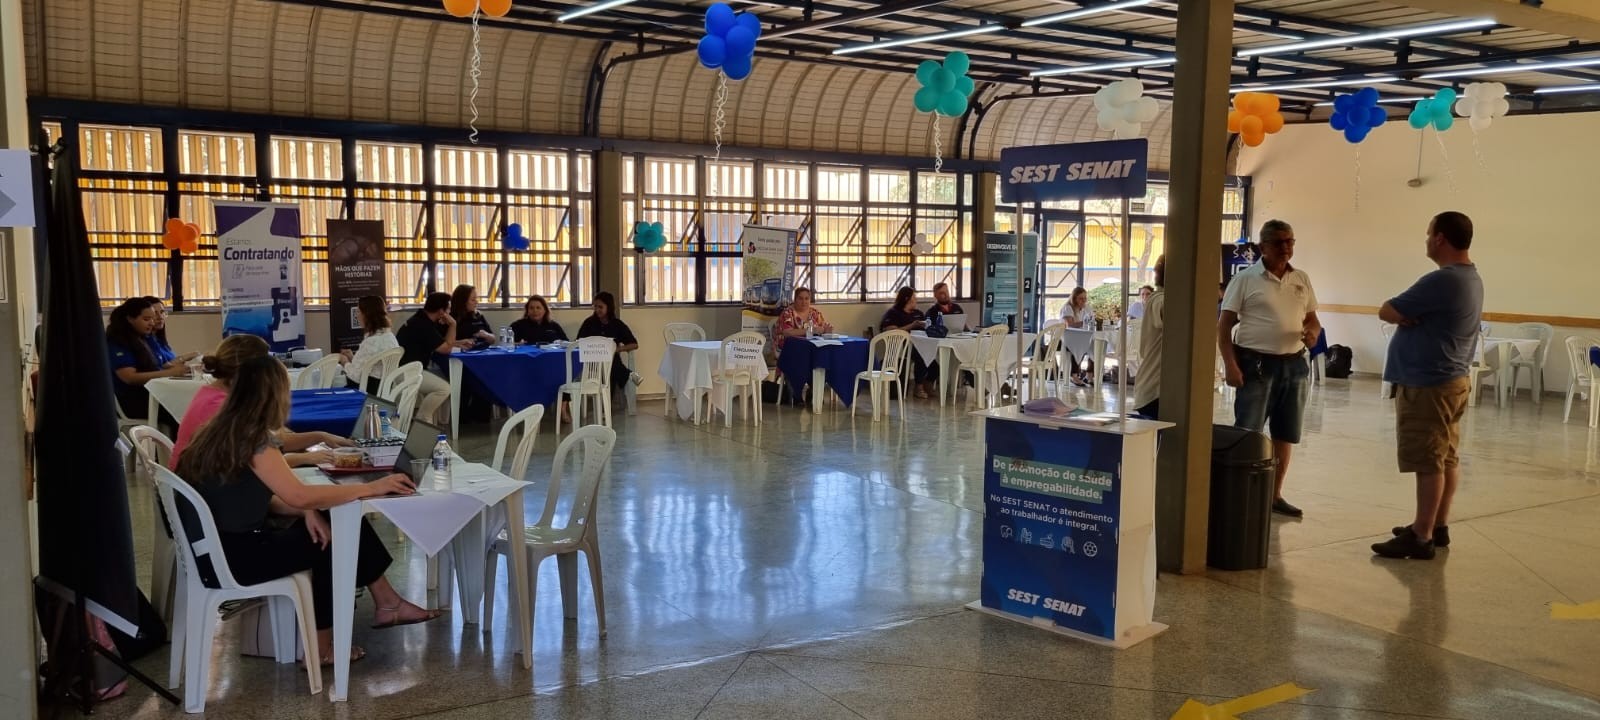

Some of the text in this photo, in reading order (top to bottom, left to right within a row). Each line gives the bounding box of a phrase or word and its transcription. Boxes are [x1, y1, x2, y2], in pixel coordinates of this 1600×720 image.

[1009, 159, 1136, 184] SEST SENAT
[224, 246, 294, 261] Contratando
[989, 264, 994, 273] 1
[1024, 280, 1030, 289] 2
[987, 295, 993, 303] 3
[993, 459, 1112, 487] De promoção de saúde
[1002, 473, 1103, 500] à empregabilidade.
[990, 494, 1001, 502] No
[1002, 496, 1021, 507] SEST
[1023, 500, 1050, 512] SENAT
[1060, 507, 1113, 523] atendimento
[1011, 509, 1056, 524] trabalhador
[1058, 516, 1063, 525] é
[1065, 518, 1100, 532] integral.
[1007, 588, 1087, 617] SEST SENAT
